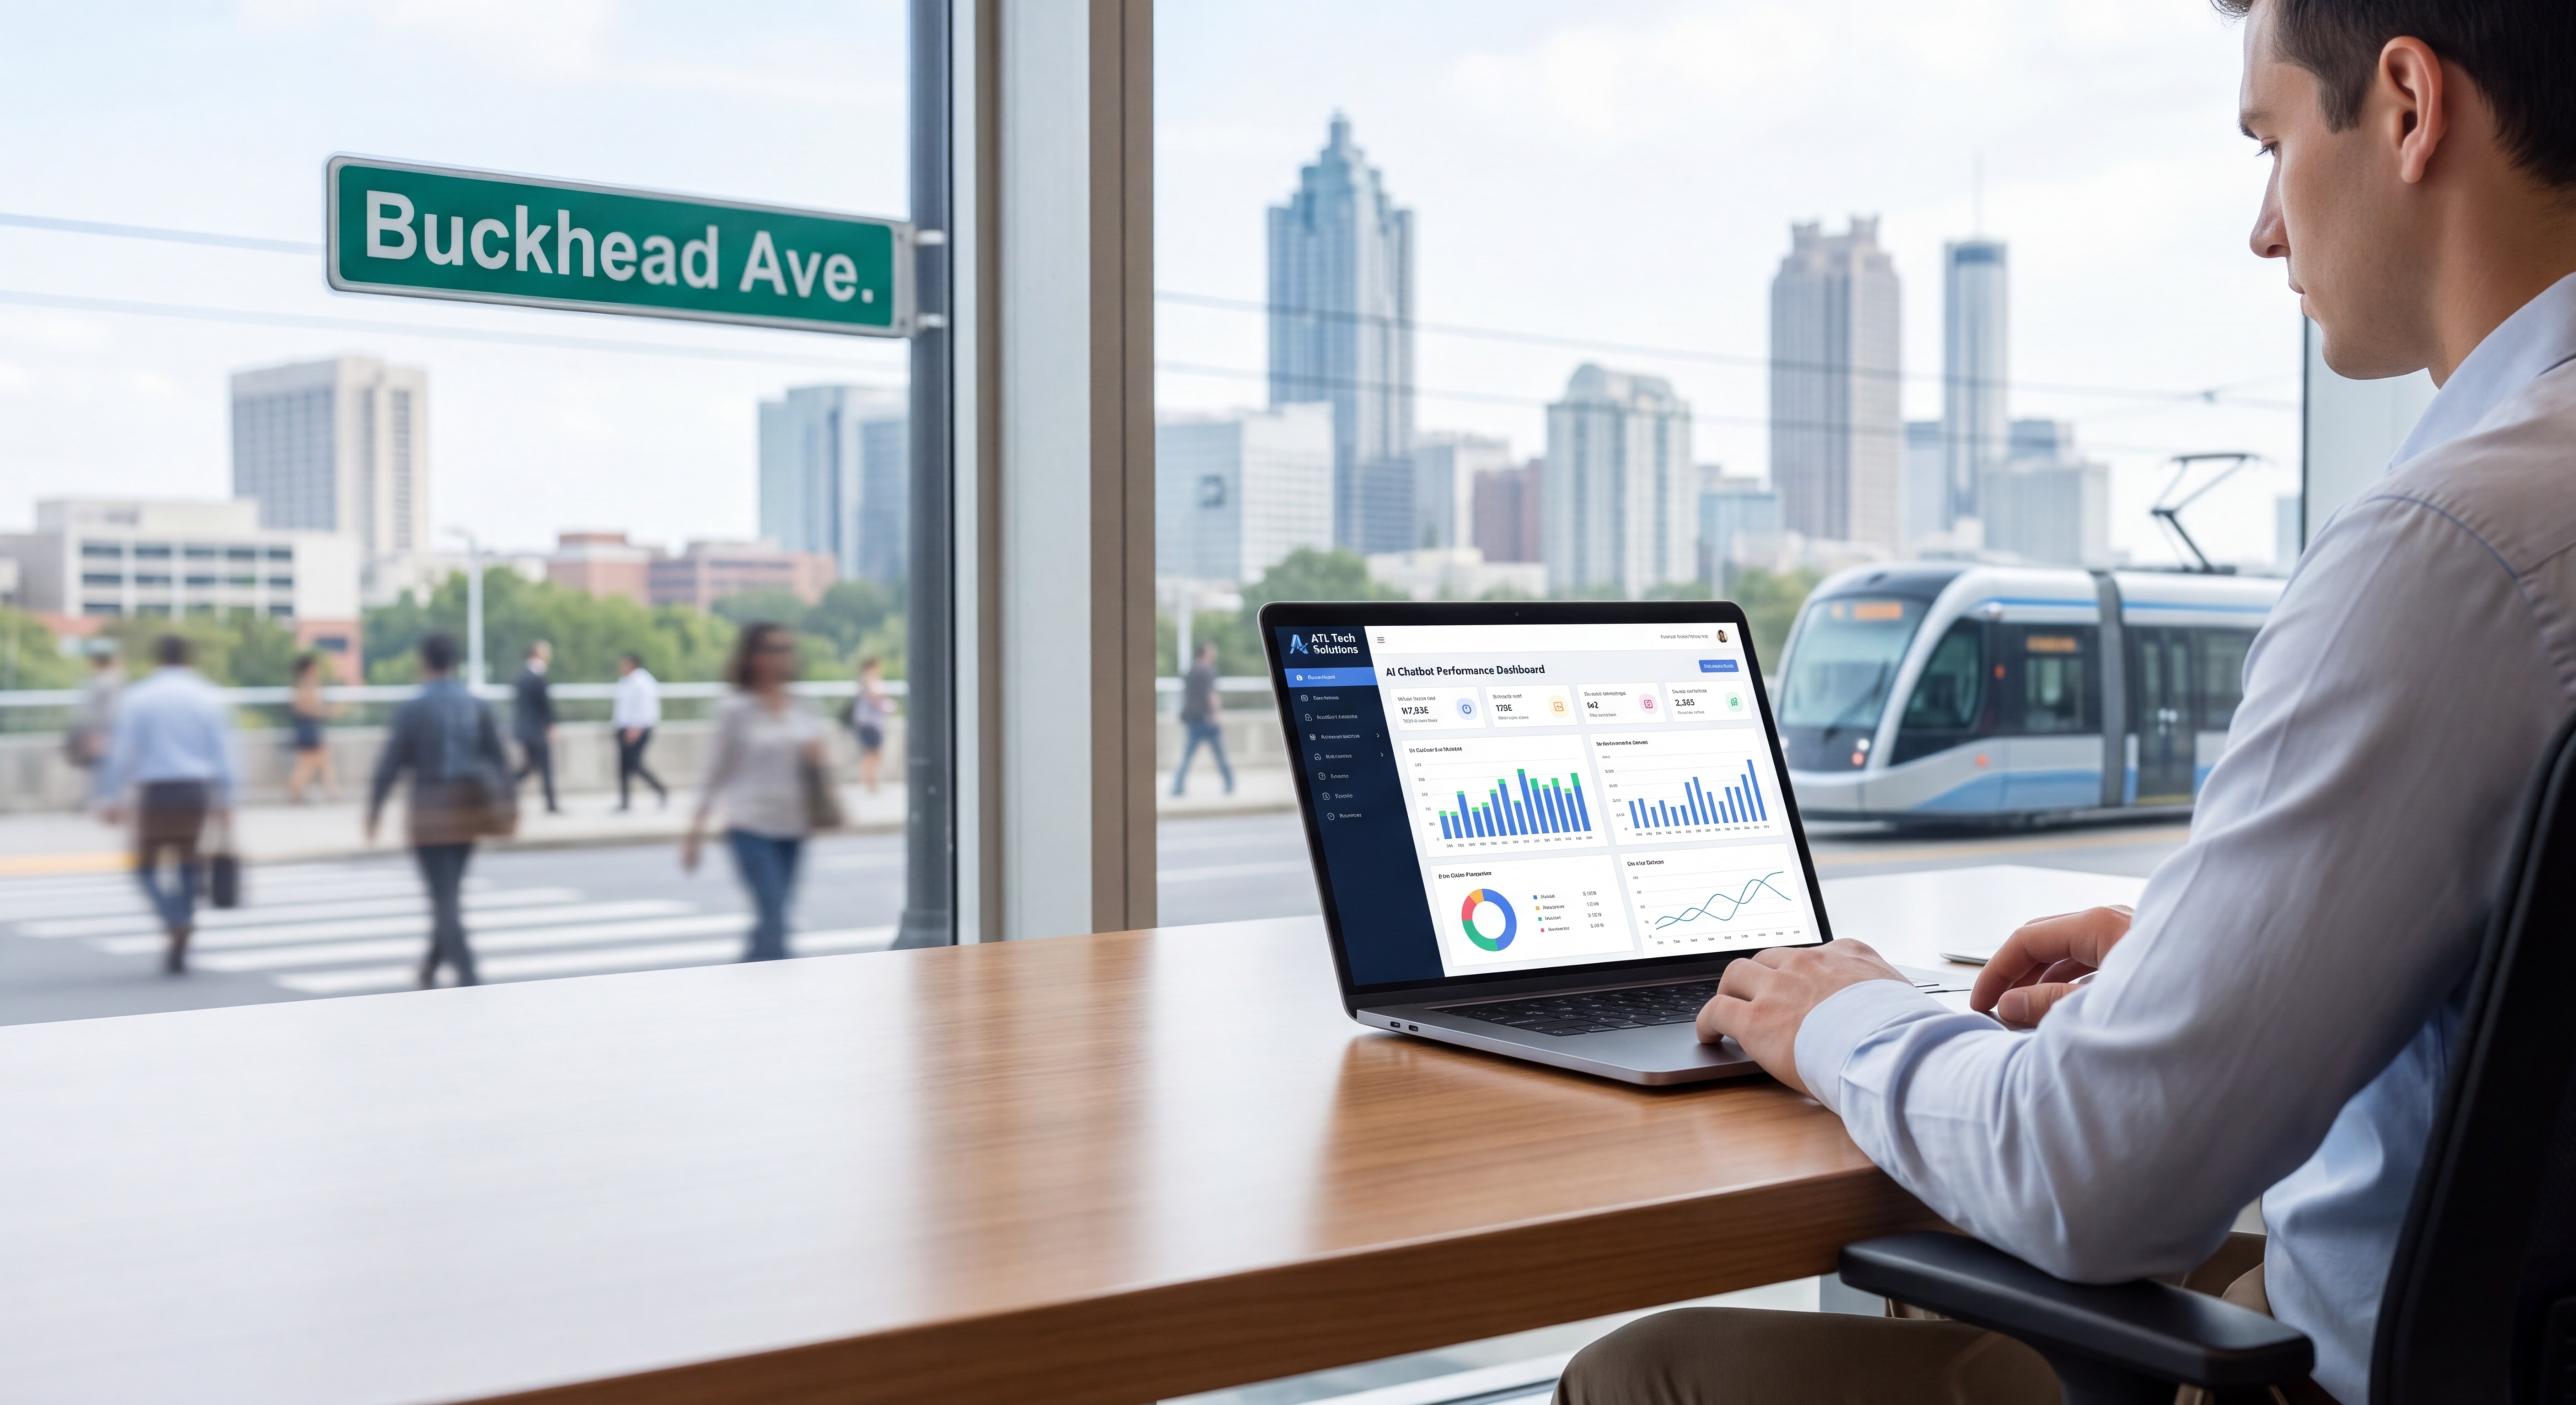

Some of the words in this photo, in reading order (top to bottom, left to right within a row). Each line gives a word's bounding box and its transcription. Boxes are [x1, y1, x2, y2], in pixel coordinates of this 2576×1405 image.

[366, 190, 719, 290] Buckhead
[739, 230, 874, 303] Ave.
[1311, 634, 1330, 643] ATL
[1331, 633, 1356, 643] Tech
[1313, 644, 1359, 654] Solutions
[1386, 668, 1396, 676] AI
[1397, 666, 1435, 676] Chatbot
[1436, 665, 1494, 676] Performance
